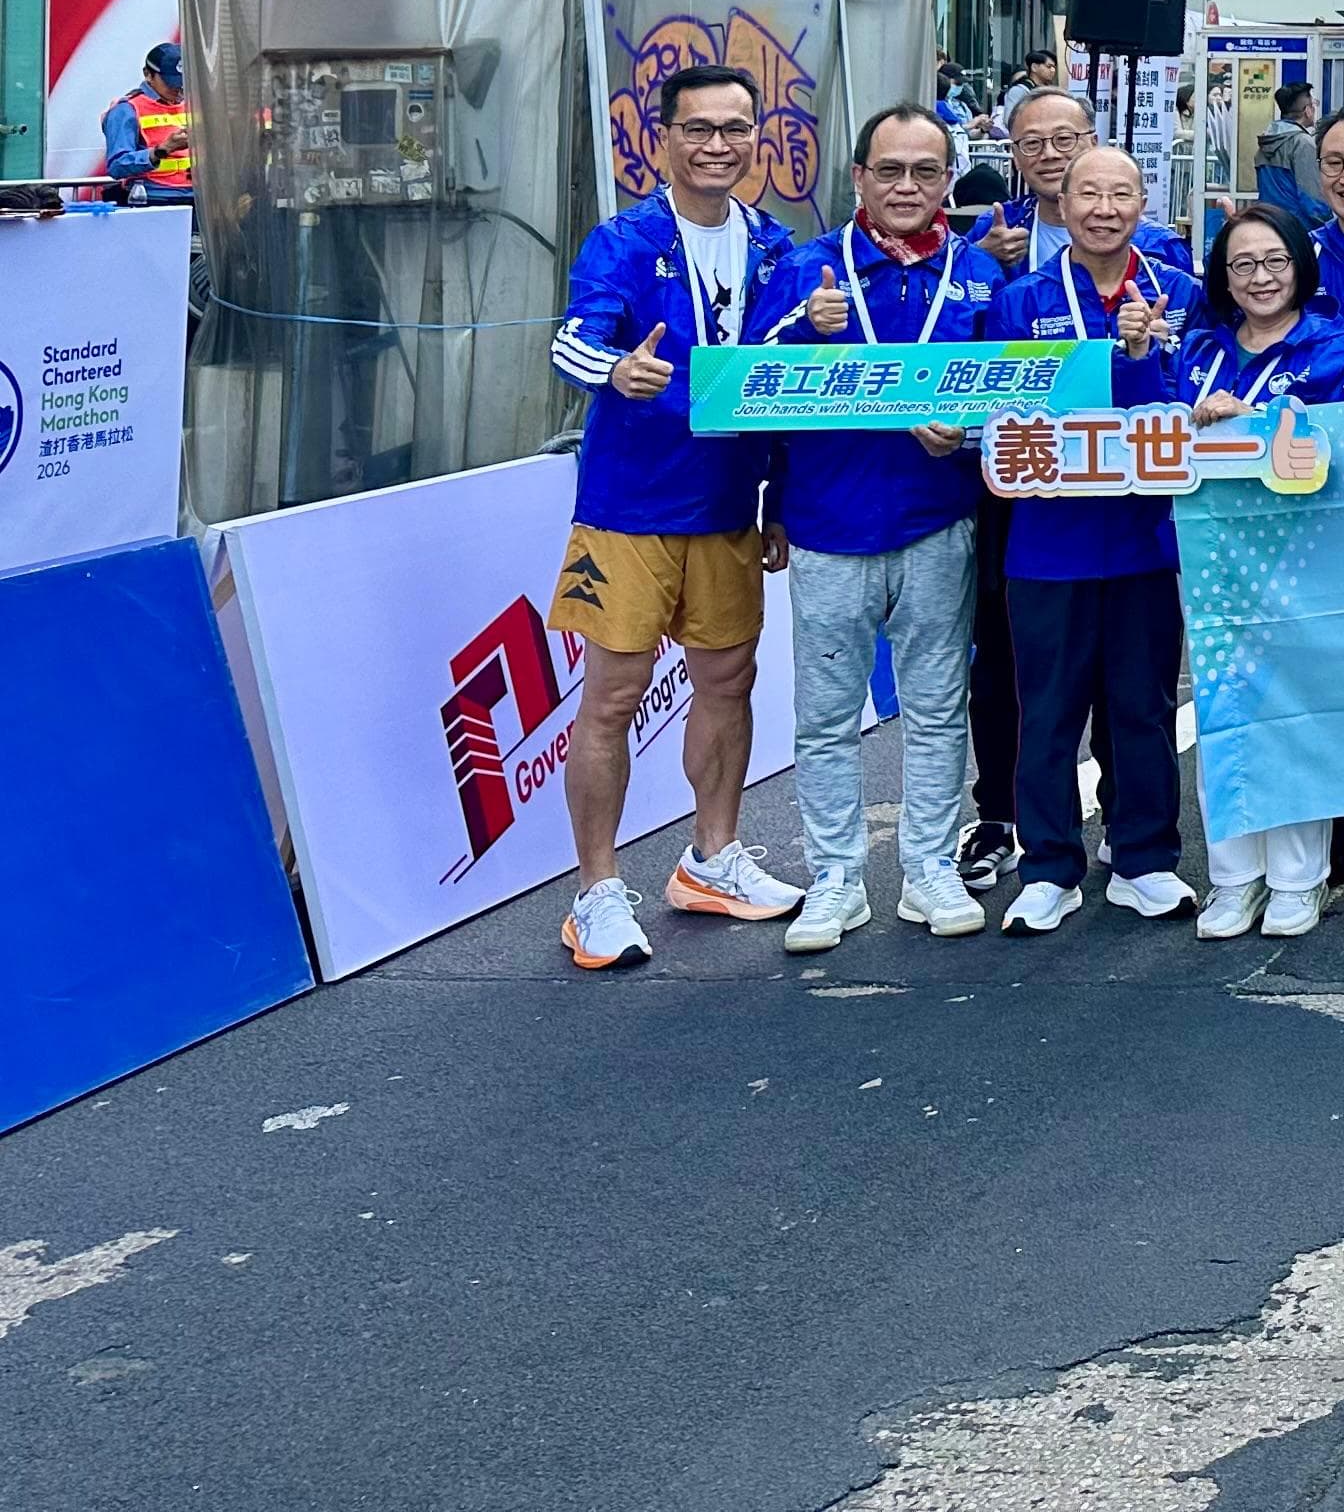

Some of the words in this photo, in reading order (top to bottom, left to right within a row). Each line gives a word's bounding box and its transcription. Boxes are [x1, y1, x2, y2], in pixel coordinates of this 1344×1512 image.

[43, 338, 118, 365] Standard
[42, 360, 122, 387] Chartered
[41, 388, 84, 412] Hong
[88, 382, 129, 406] Kong
[734, 401, 769, 417] Join
[770, 401, 817, 416] hands
[819, 401, 850, 415] with
[854, 400, 932, 416] Volunteers,
[938, 401, 958, 414] we
[961, 400, 987, 414] run
[40, 408, 119, 434] Marathon
[38, 425, 134, 458] 渣打香港馬拉松
[995, 415, 1260, 484] 義工世一
[37, 460, 71, 481] 2026
